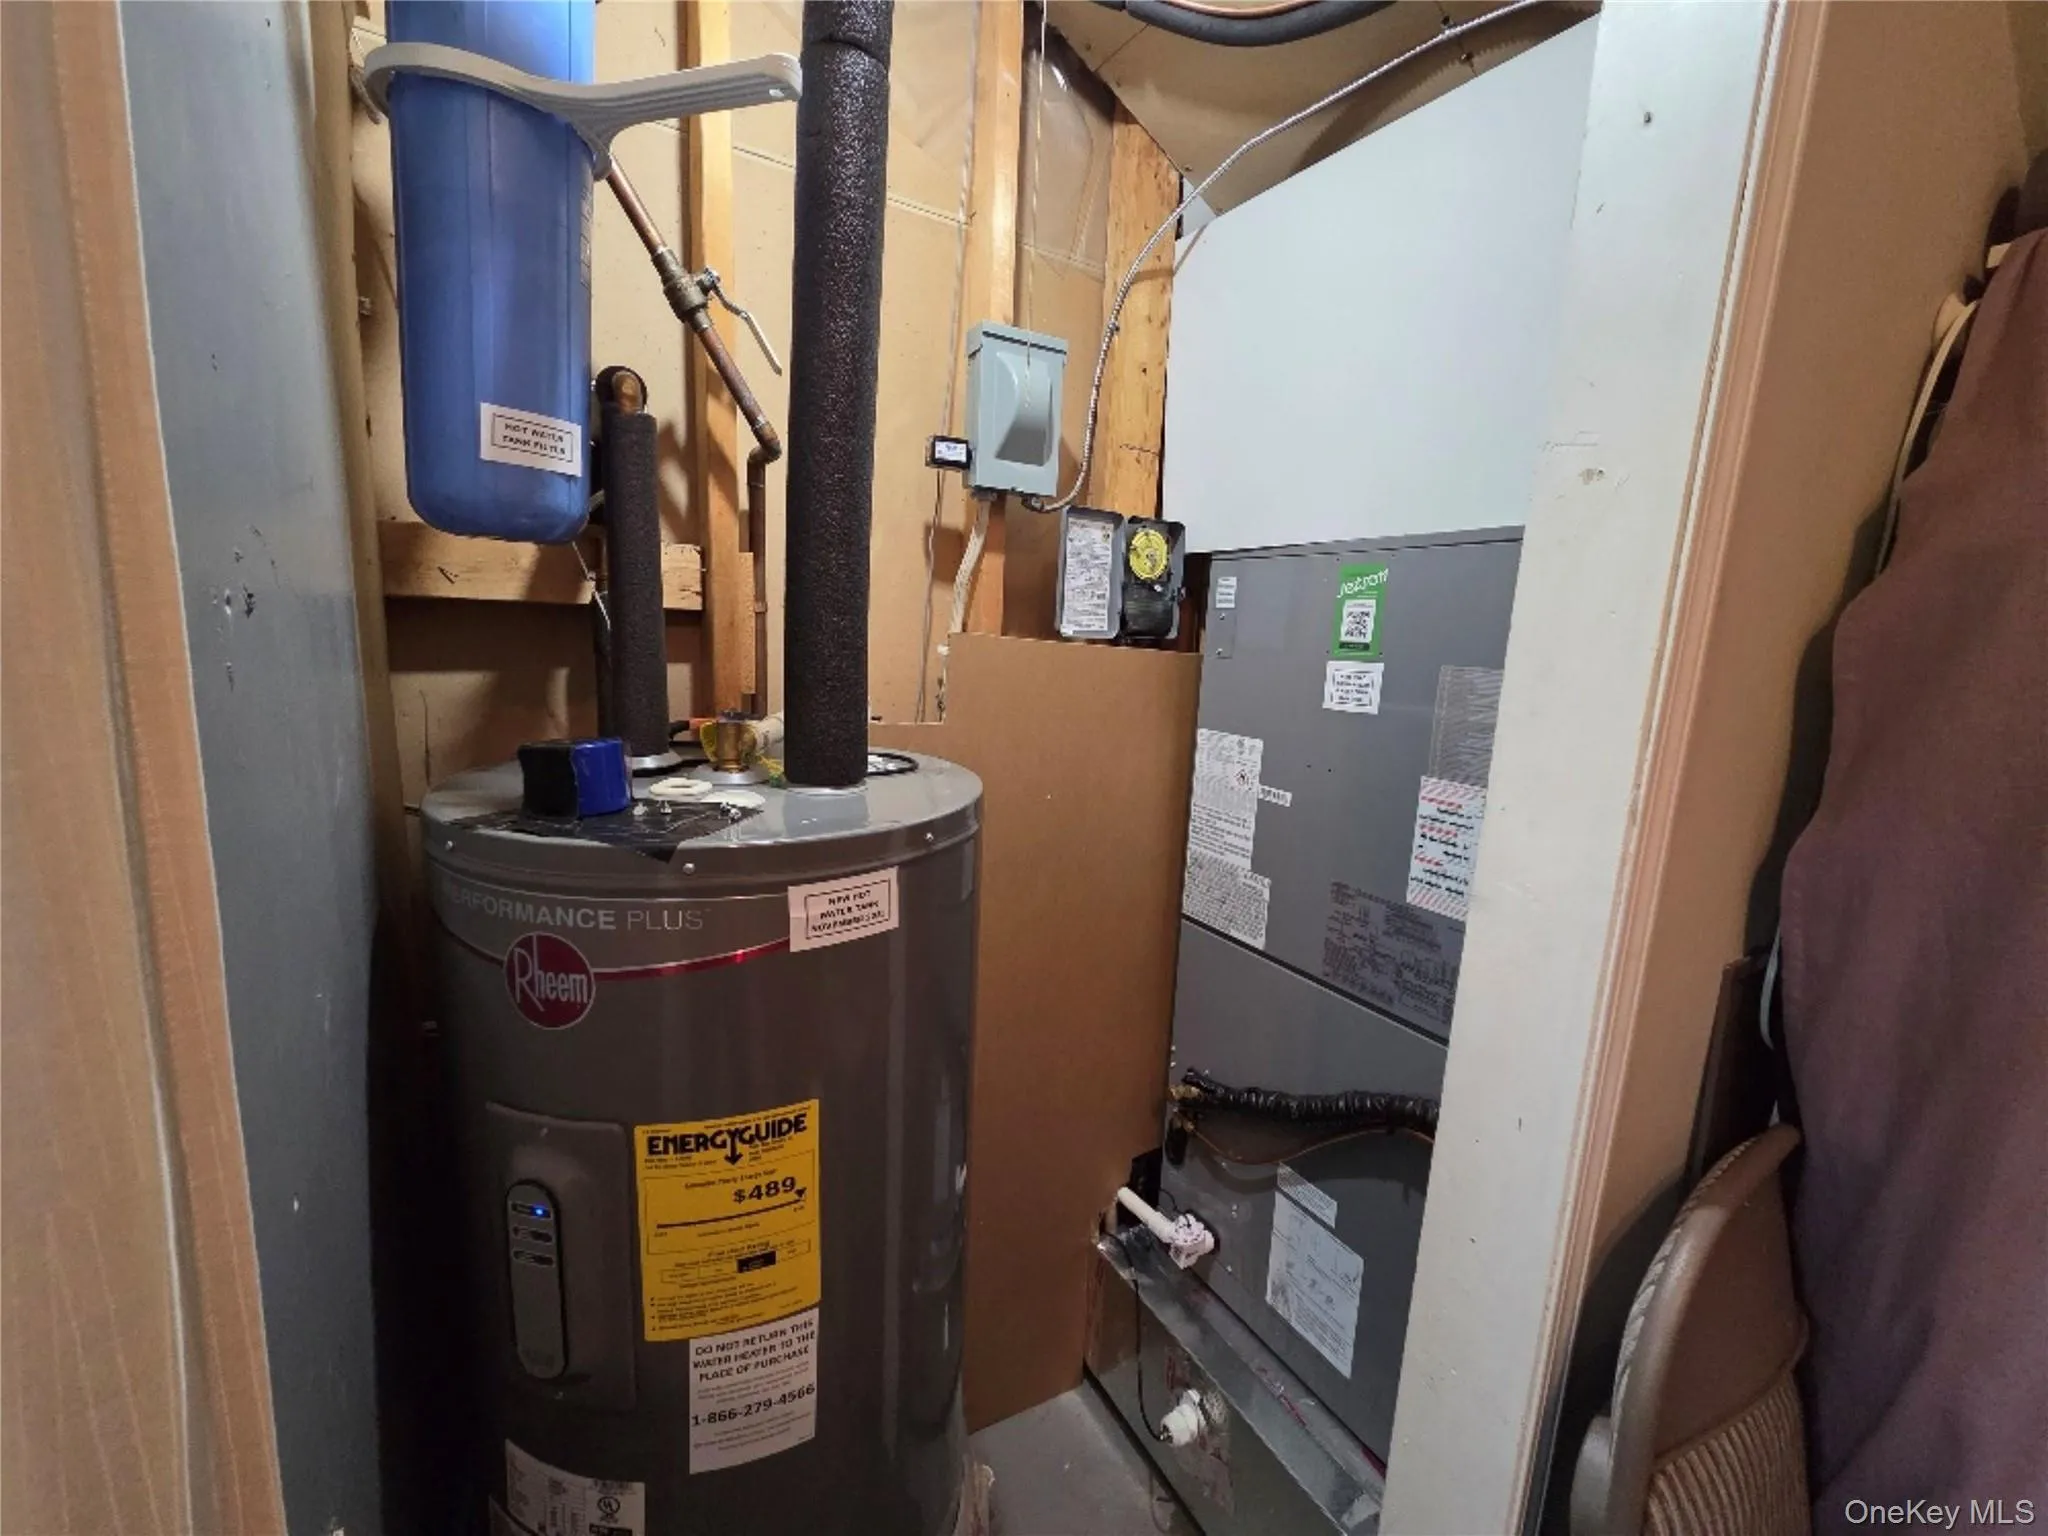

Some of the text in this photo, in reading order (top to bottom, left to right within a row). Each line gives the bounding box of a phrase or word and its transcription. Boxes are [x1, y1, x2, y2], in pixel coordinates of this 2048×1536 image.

[627, 910, 703, 930] PLUS
[512, 934, 588, 1012] Rheem
[733, 1176, 797, 1205] $489
[692, 1330, 816, 1369] WATER HEATER TO THE
[695, 1317, 814, 1356] DO NOT RETURN THIS
[699, 1344, 810, 1383] PLACE OF PURCHASE
